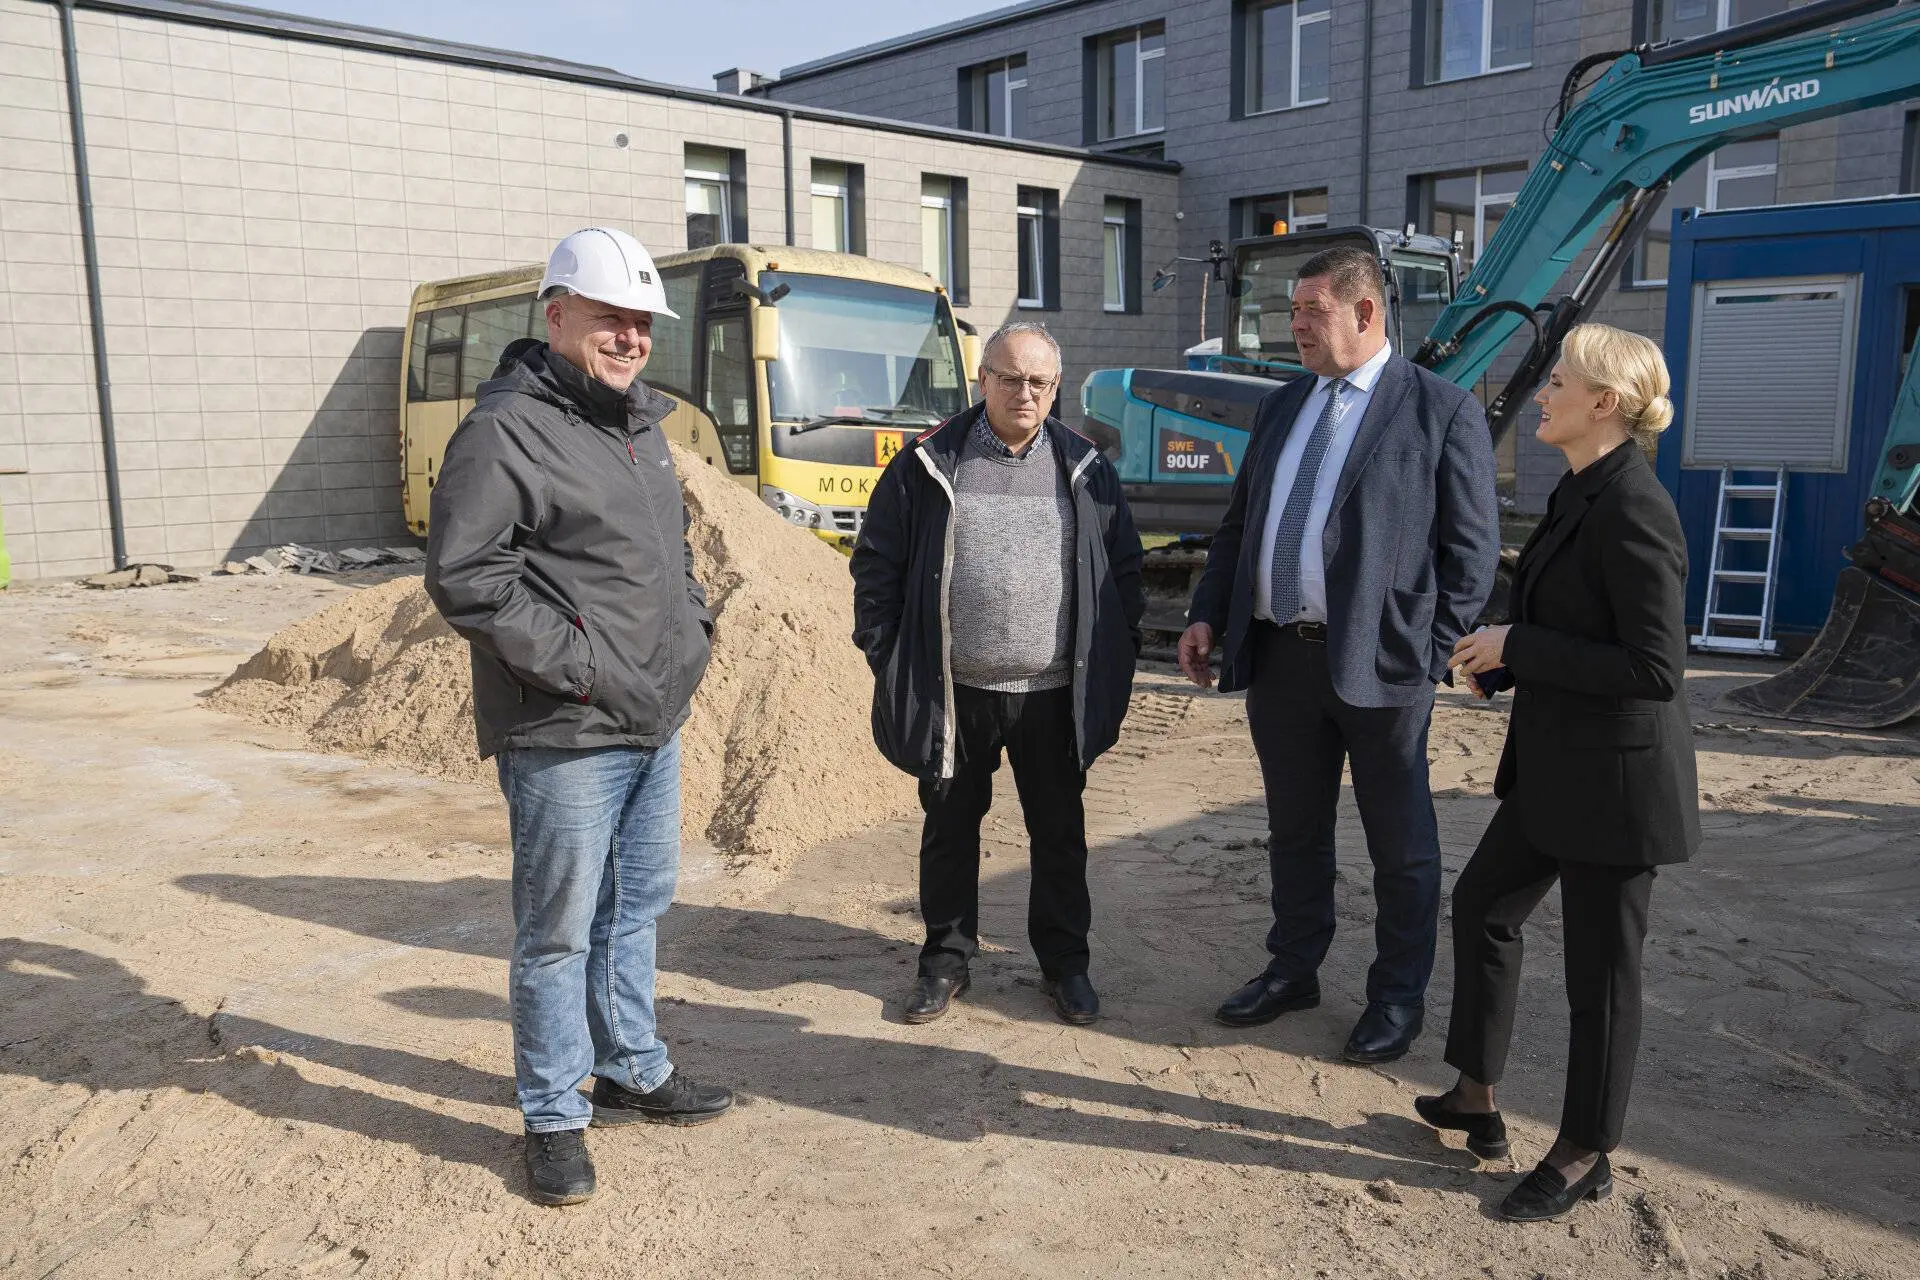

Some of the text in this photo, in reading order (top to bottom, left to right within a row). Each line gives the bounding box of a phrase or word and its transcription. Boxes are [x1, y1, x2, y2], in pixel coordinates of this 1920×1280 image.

[1689, 77, 1820, 124] SUNWARD
[1167, 441, 1195, 452] SWE
[1166, 454, 1210, 469] 90UF
[819, 477, 878, 493] MOK
